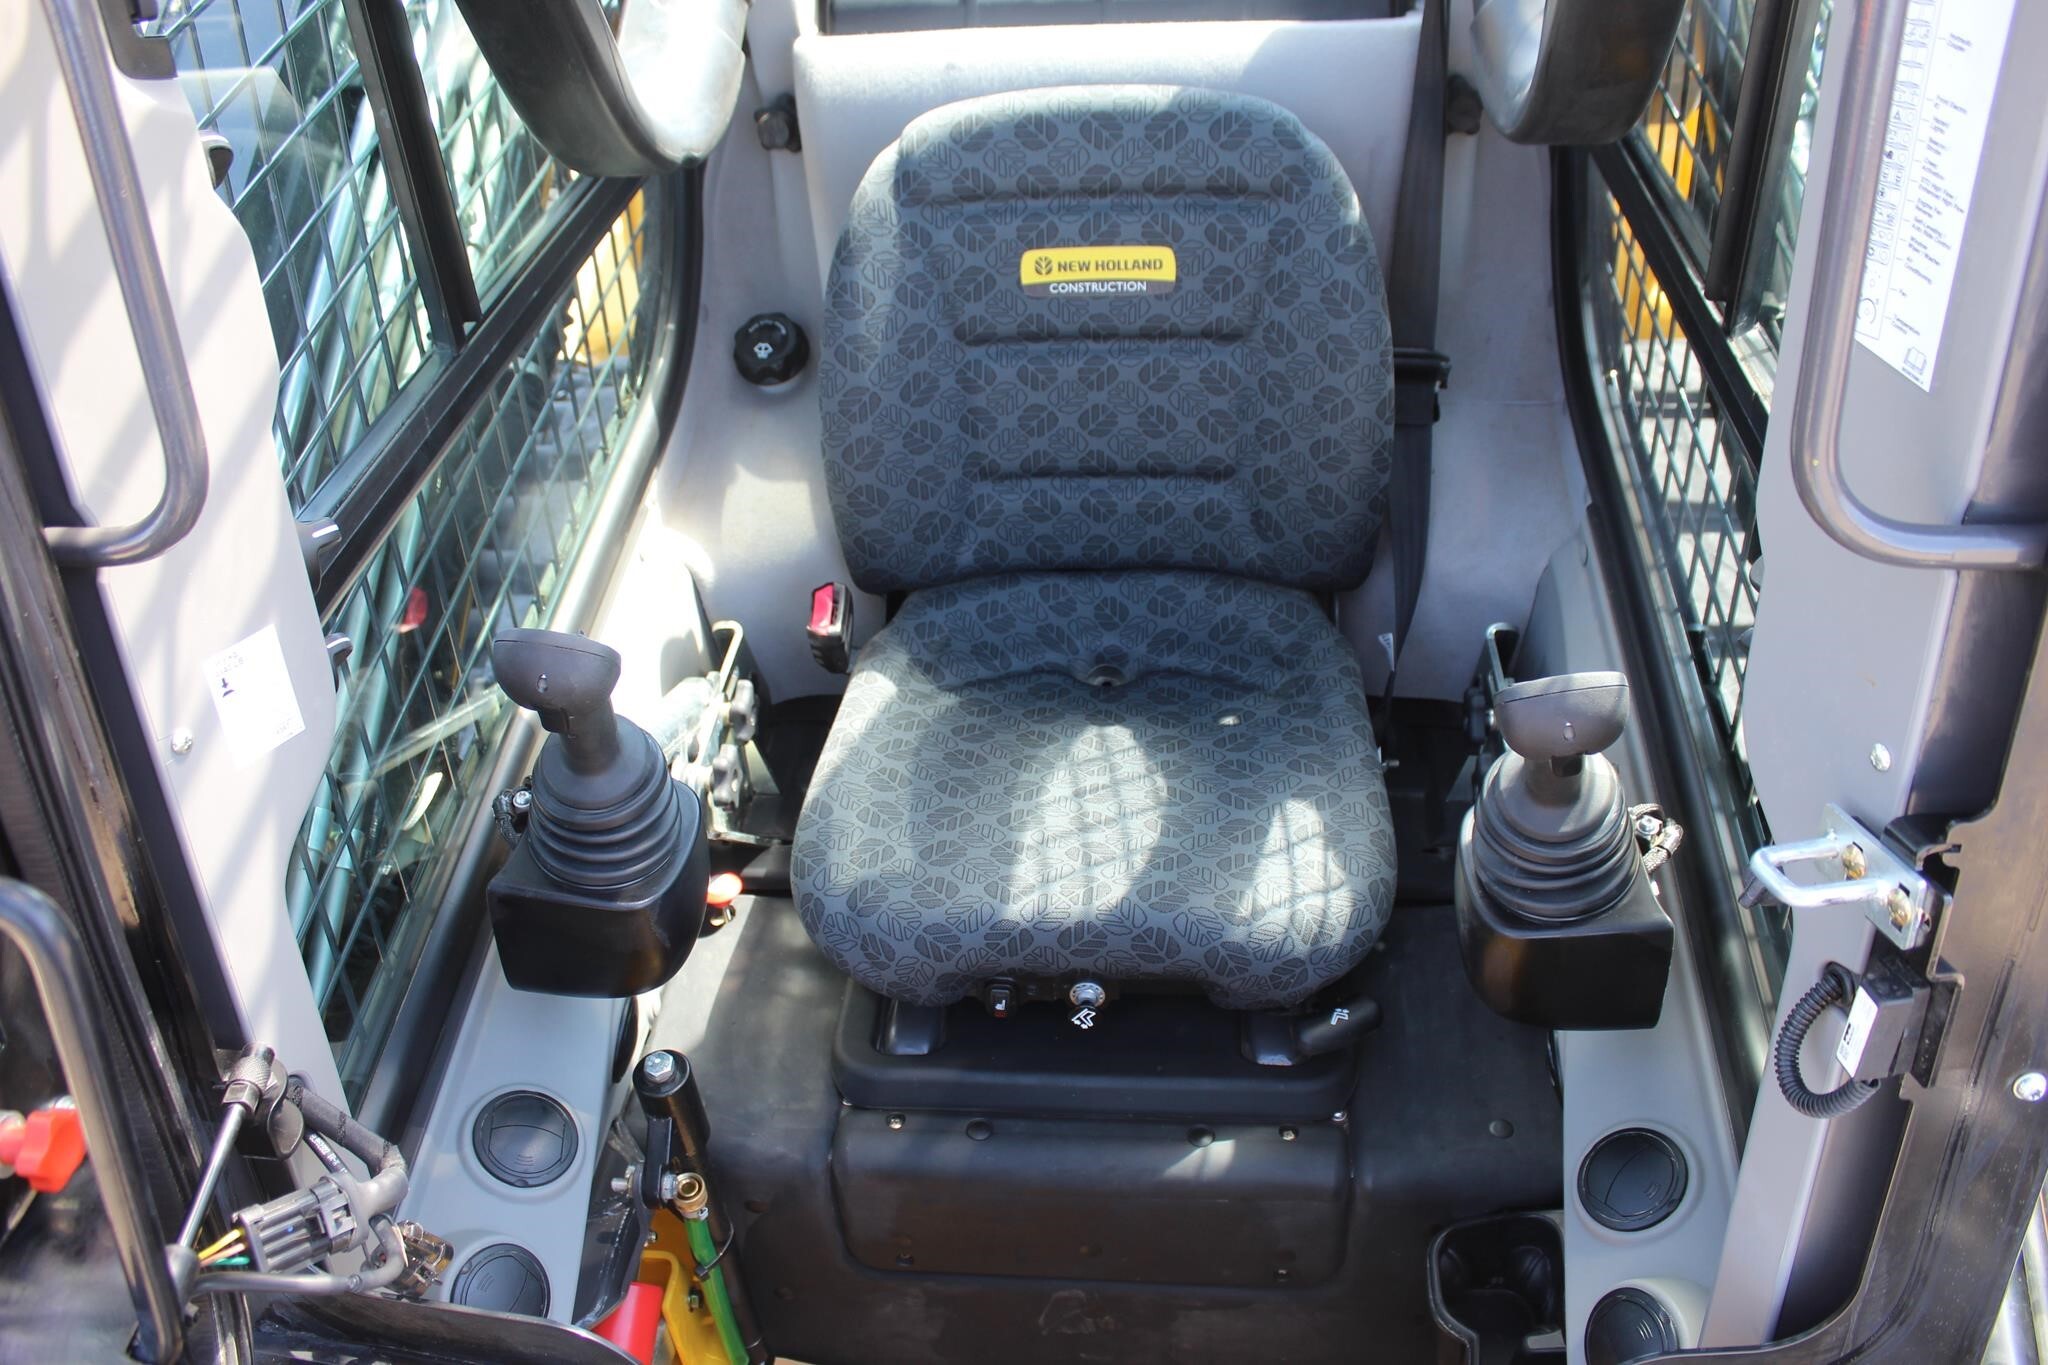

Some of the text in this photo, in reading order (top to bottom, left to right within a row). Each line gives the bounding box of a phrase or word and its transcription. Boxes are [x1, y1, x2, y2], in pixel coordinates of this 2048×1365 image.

[1058, 258, 1163, 272] NEW HOLLAND
[1050, 281, 1147, 294] CONSTRUCTION
